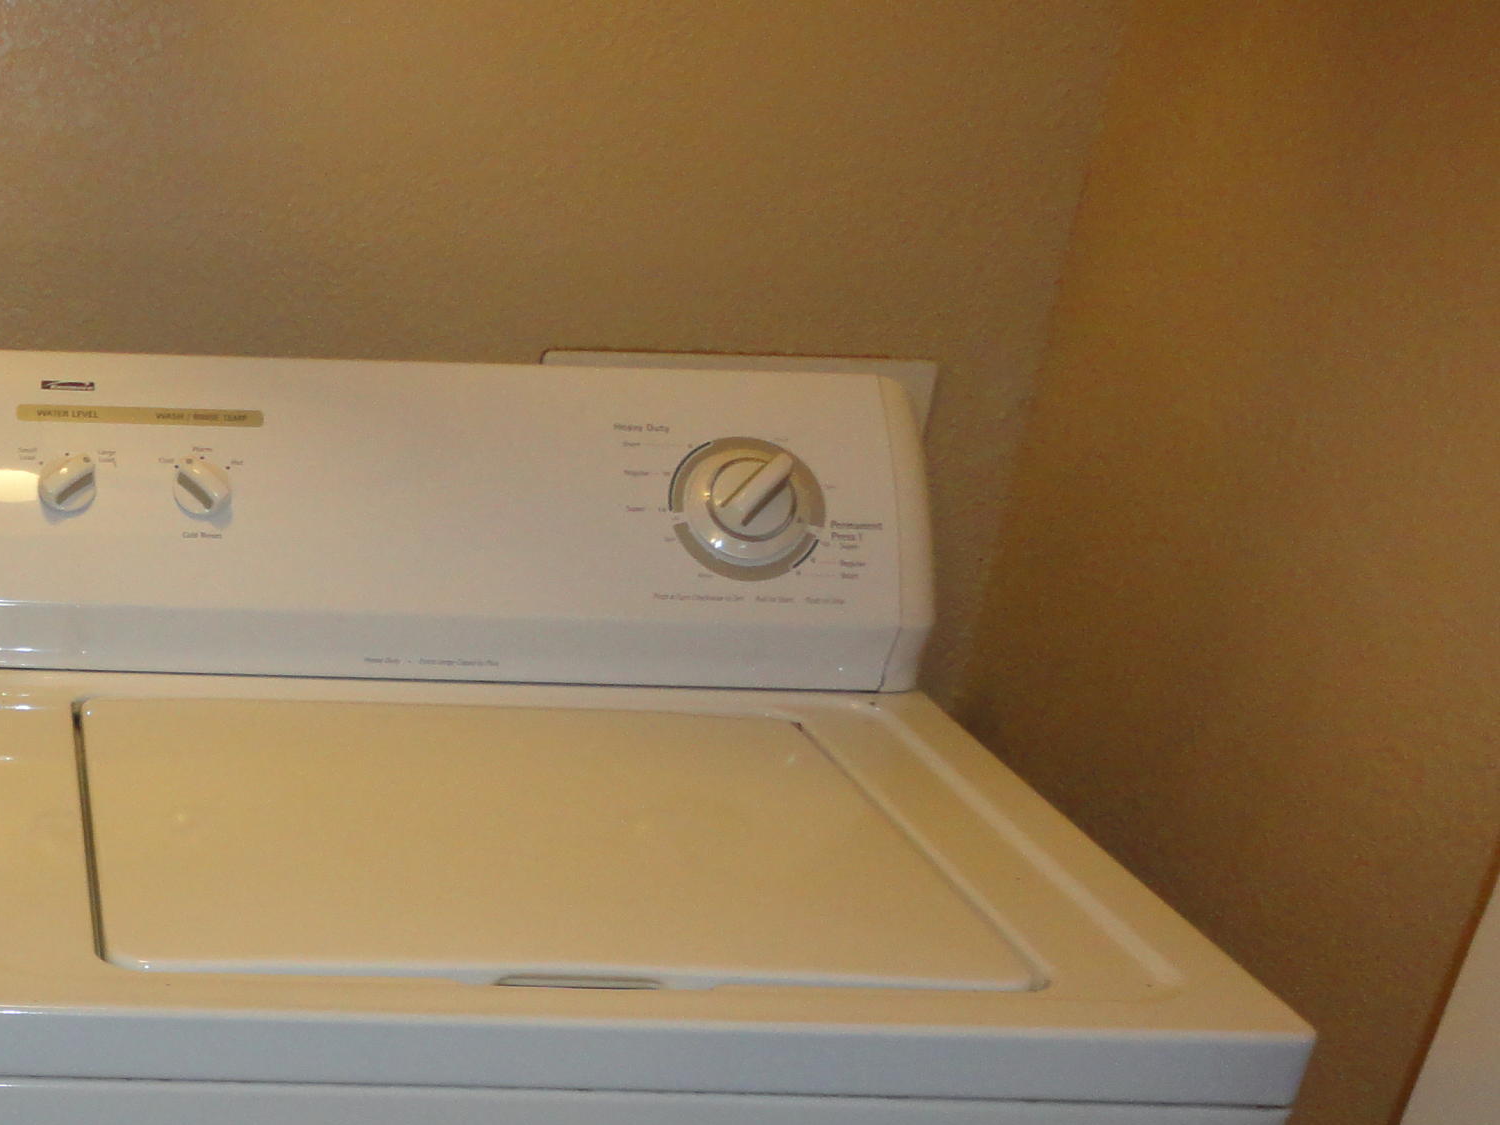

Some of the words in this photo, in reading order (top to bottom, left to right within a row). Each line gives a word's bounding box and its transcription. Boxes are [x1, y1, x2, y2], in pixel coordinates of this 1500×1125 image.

[36, 409, 69, 418] WATER
[71, 410, 99, 419] LEVEL
[155, 412, 184, 421] WASH
[646, 423, 670, 435] Duty
